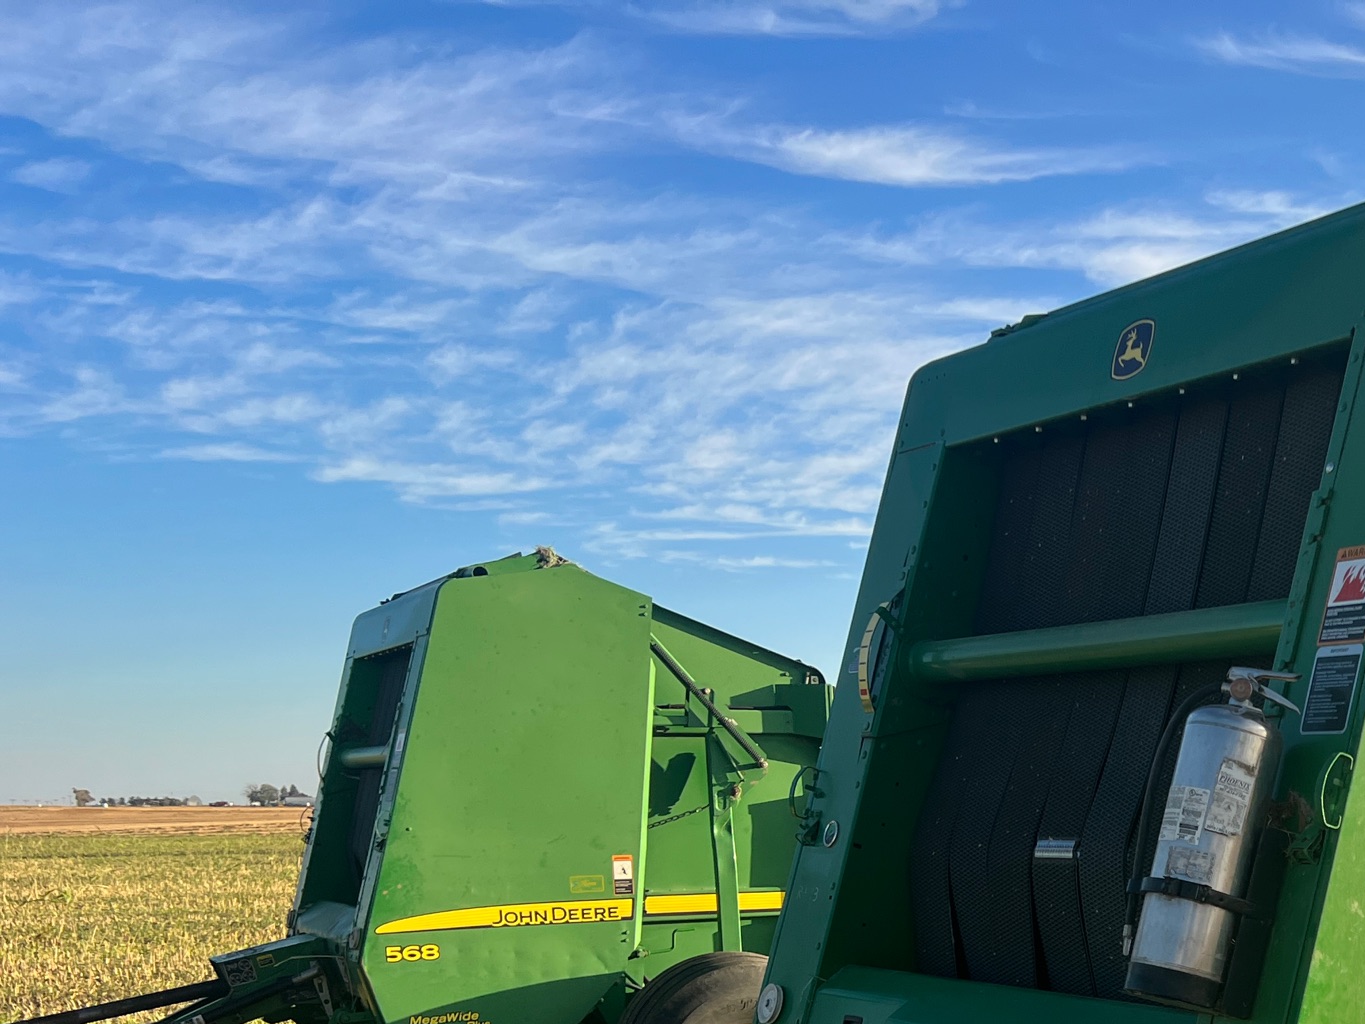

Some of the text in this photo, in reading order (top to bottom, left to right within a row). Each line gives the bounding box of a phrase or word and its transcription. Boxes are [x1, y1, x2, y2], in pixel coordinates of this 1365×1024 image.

[1219, 775, 1251, 791] PHOENIX
[494, 906, 619, 925] JOHN DEERE
[385, 944, 440, 963] 568
